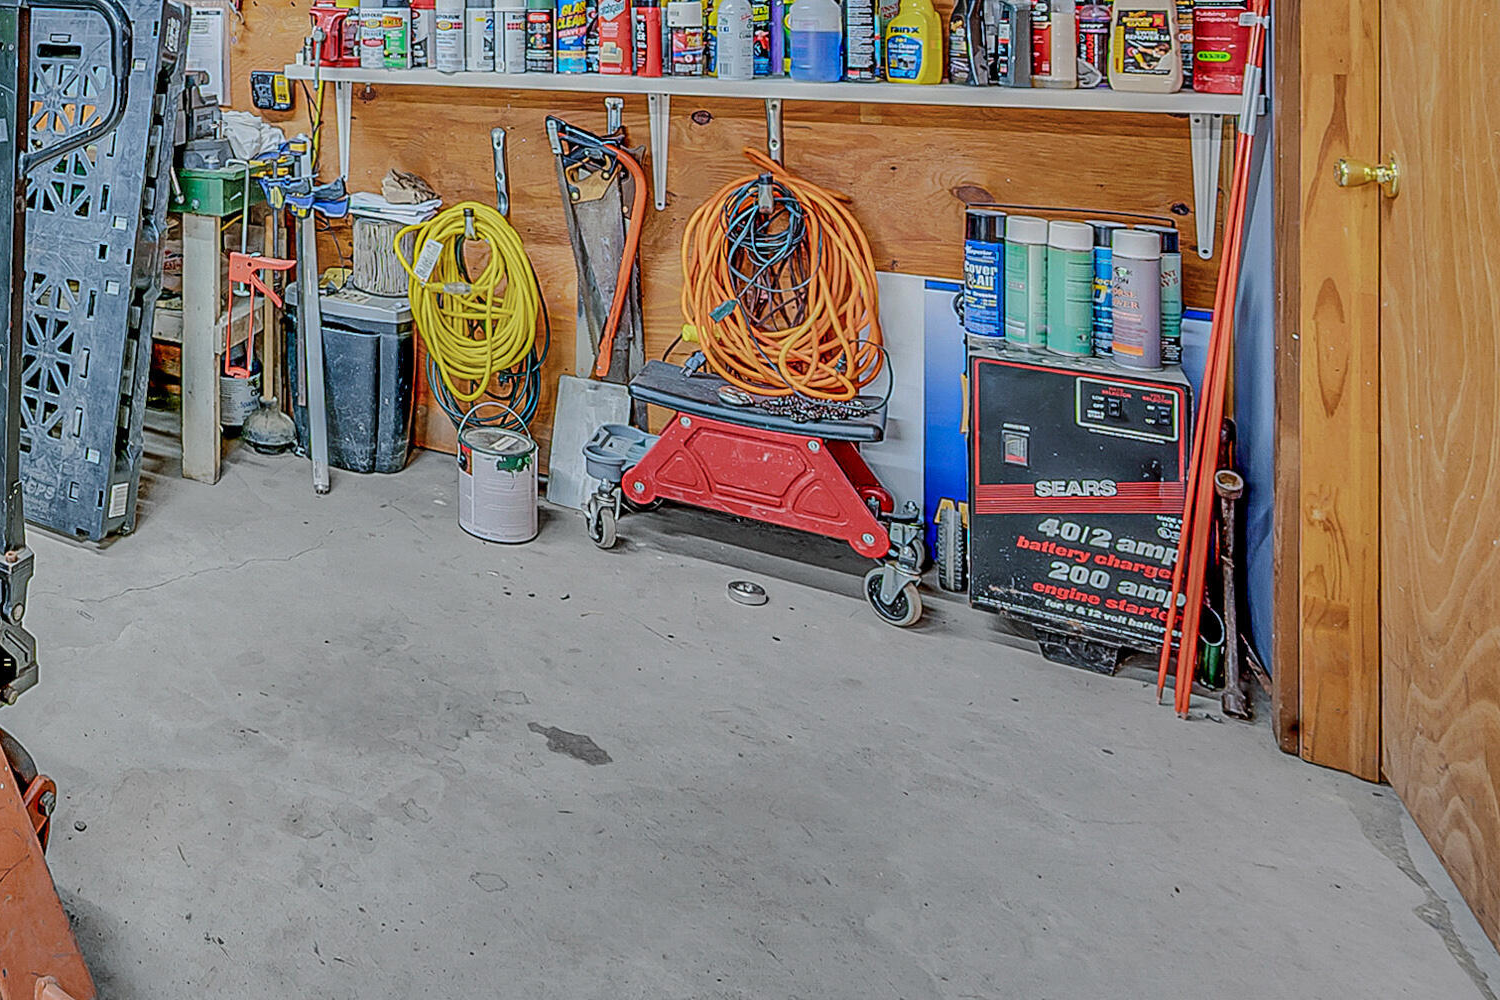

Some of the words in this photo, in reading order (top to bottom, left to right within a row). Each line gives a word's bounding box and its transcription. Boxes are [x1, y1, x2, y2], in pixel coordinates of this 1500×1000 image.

[561, 1, 587, 17] GLAS
[557, 13, 587, 30] CLEANE
[964, 260, 998, 276] Cover
[977, 275, 994, 288] All
[1035, 480, 1117, 497] SEARS
[1016, 536, 1090, 563] battery
[1038, 518, 1113, 549] 40/2
[1116, 537, 1179, 566] amp
[1032, 581, 1101, 605] engine
[1048, 561, 1111, 590] 200
[1118, 580, 1187, 608] amp
[1045, 599, 1064, 611] for
[1087, 608, 1101, 619] 12
[1103, 612, 1127, 625] volt
[1128, 616, 1183, 639] batteres
